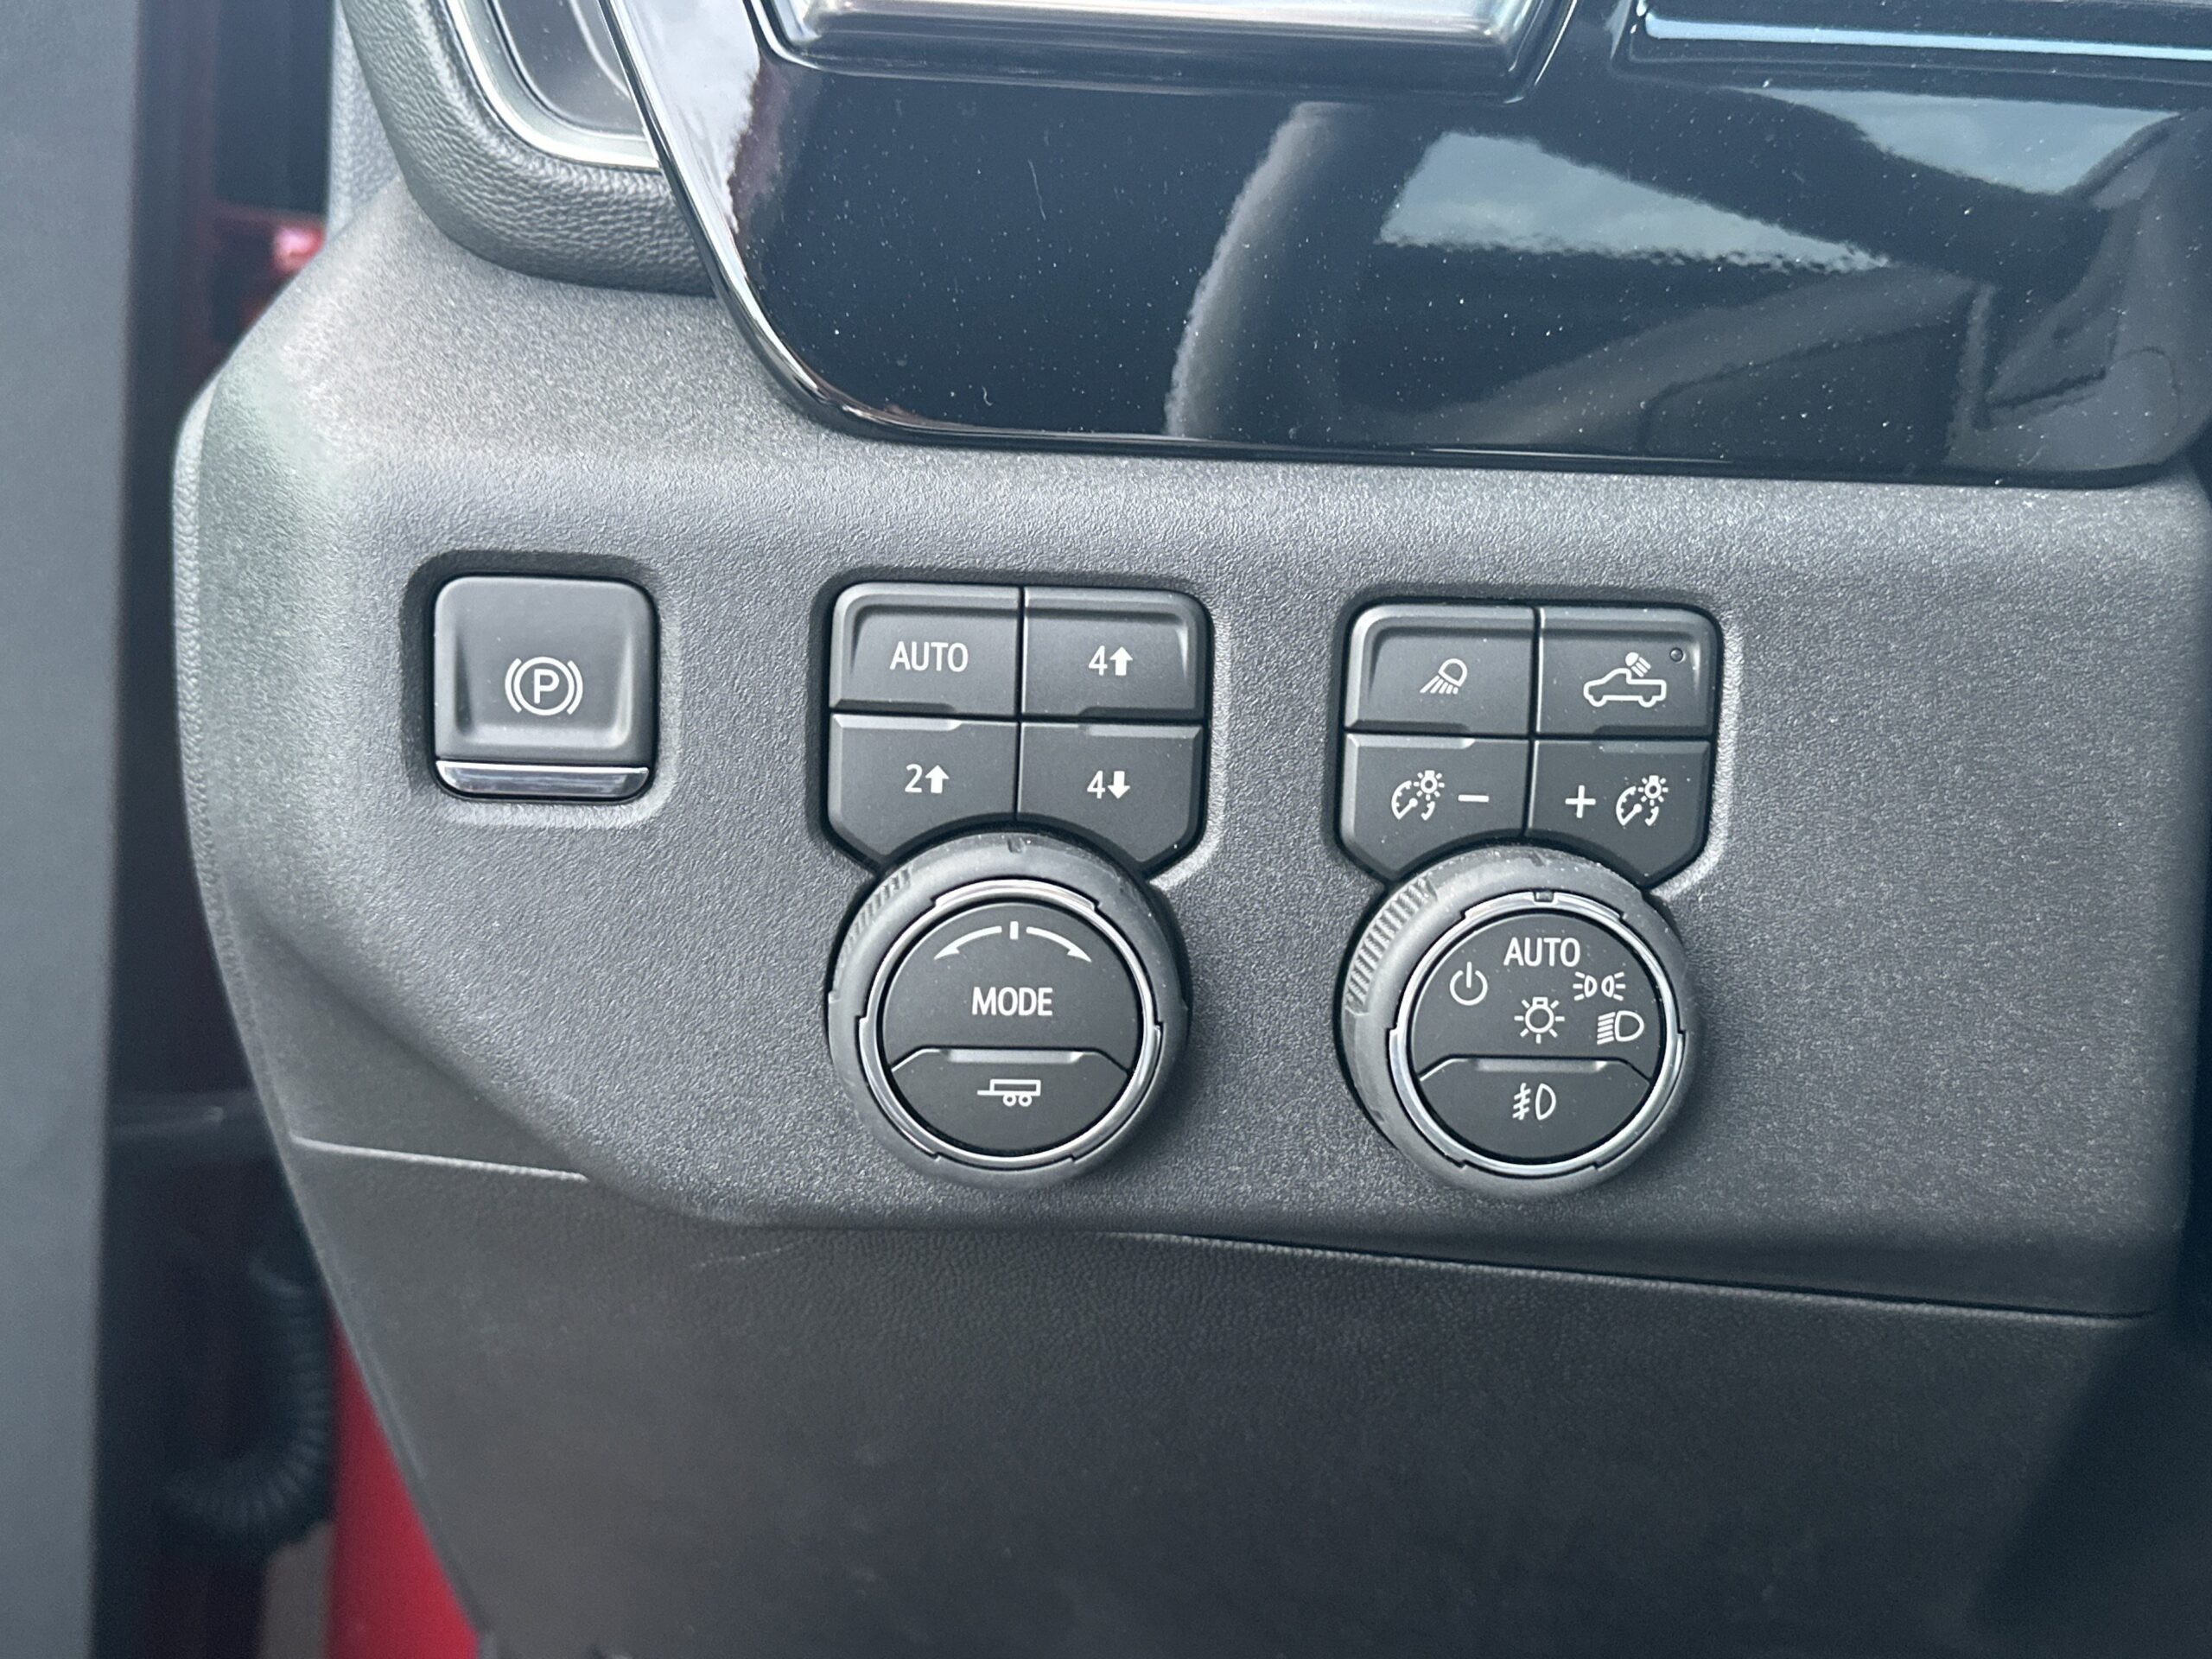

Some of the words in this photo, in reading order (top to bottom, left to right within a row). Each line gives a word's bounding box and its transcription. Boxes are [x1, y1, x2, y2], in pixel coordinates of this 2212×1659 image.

[890, 641, 969, 672] AUTO
[533, 668, 560, 704] P
[1503, 937, 1580, 967] AUTO
[971, 986, 1053, 1016] MODE
